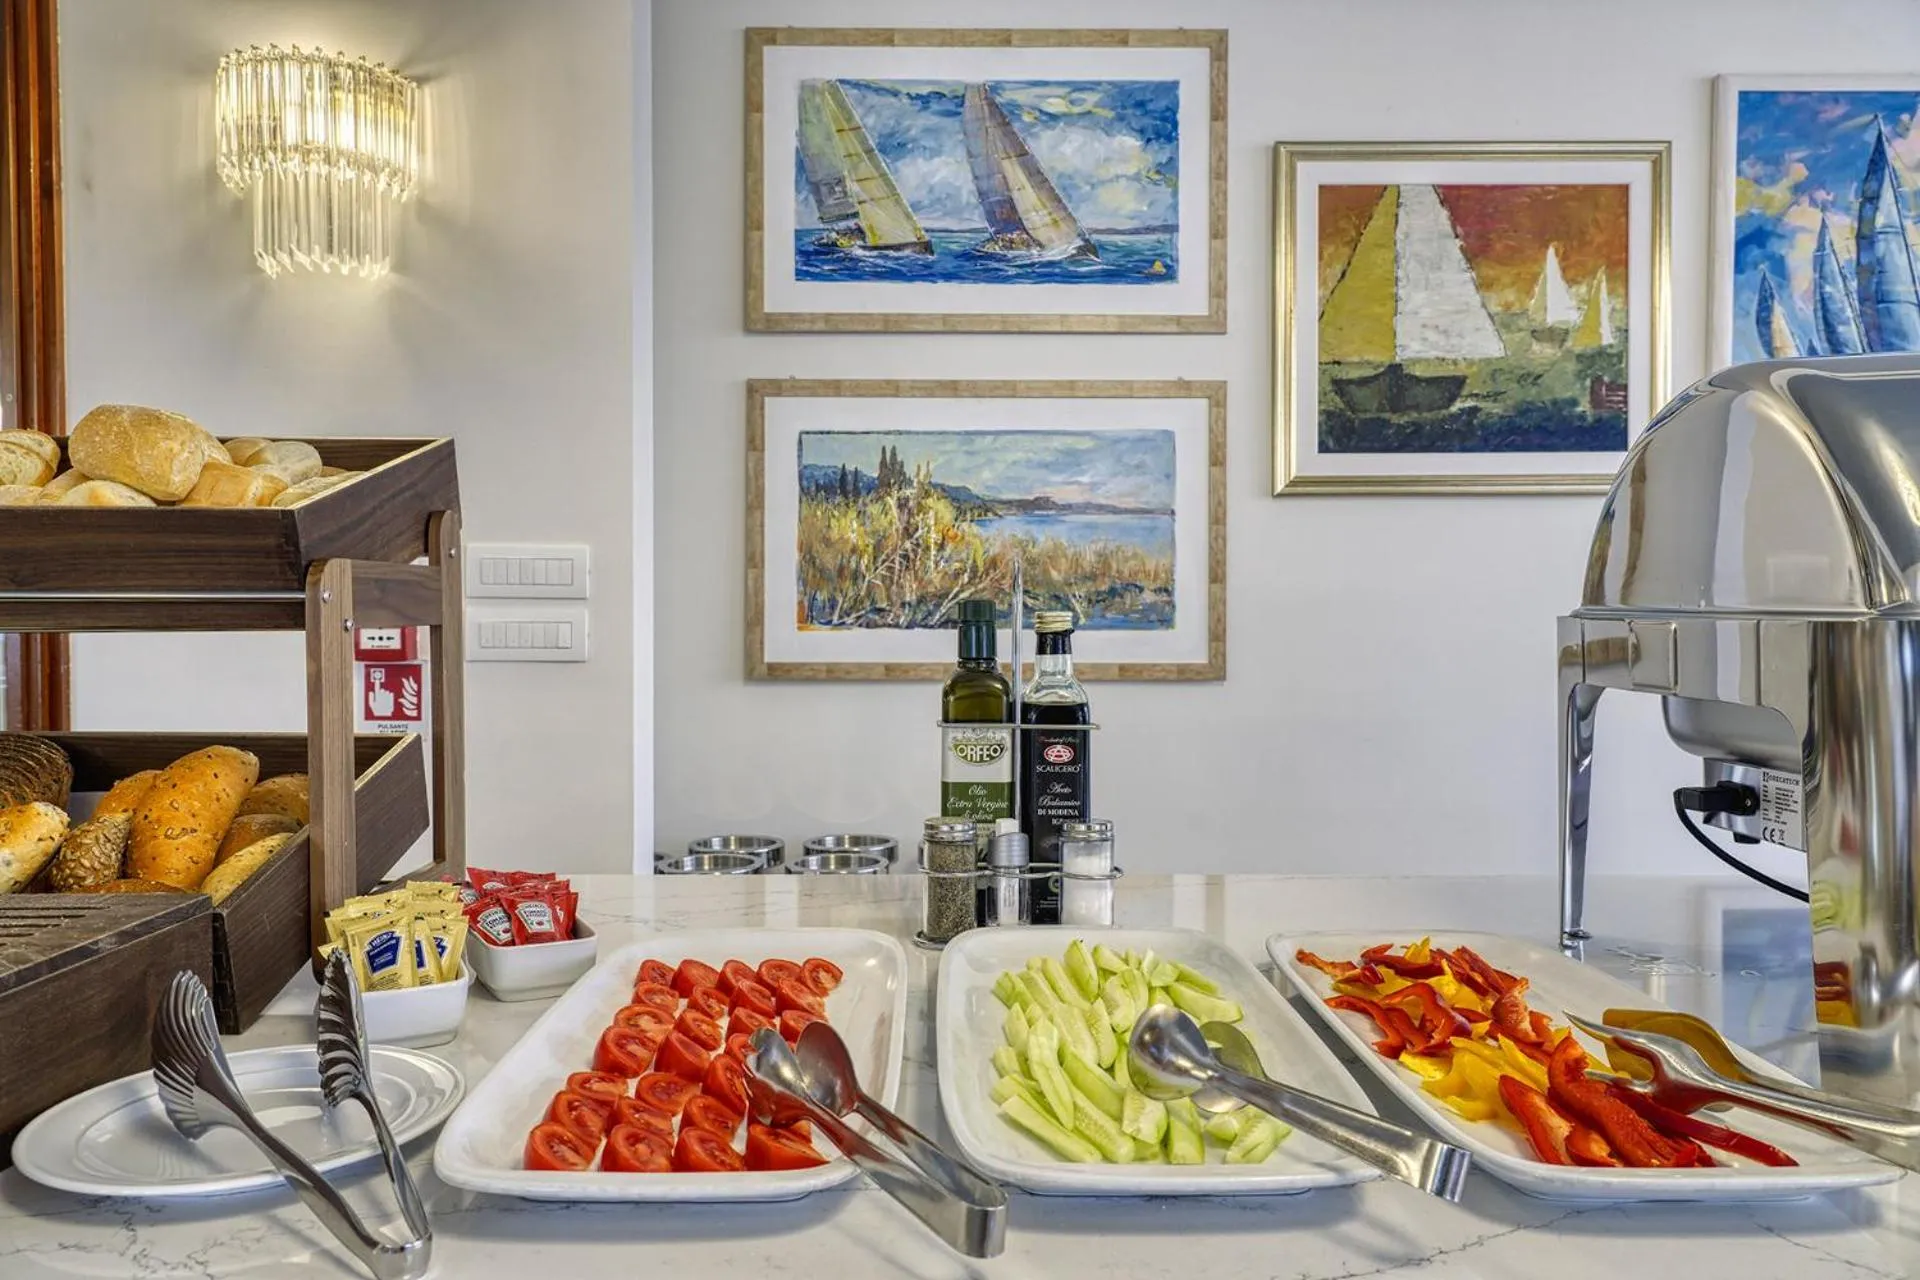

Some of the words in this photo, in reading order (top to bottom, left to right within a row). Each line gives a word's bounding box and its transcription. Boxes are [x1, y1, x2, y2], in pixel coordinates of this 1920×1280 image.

[957, 745, 1001, 761] ORFEO
[1036, 764, 1080, 773] SCALIGERO
[968, 784, 987, 796] Olio
[946, 796, 973, 809] Extra
[977, 796, 1009, 811] Vergine
[1037, 808, 1046, 816] DI
[1048, 808, 1079, 816] MODENA
